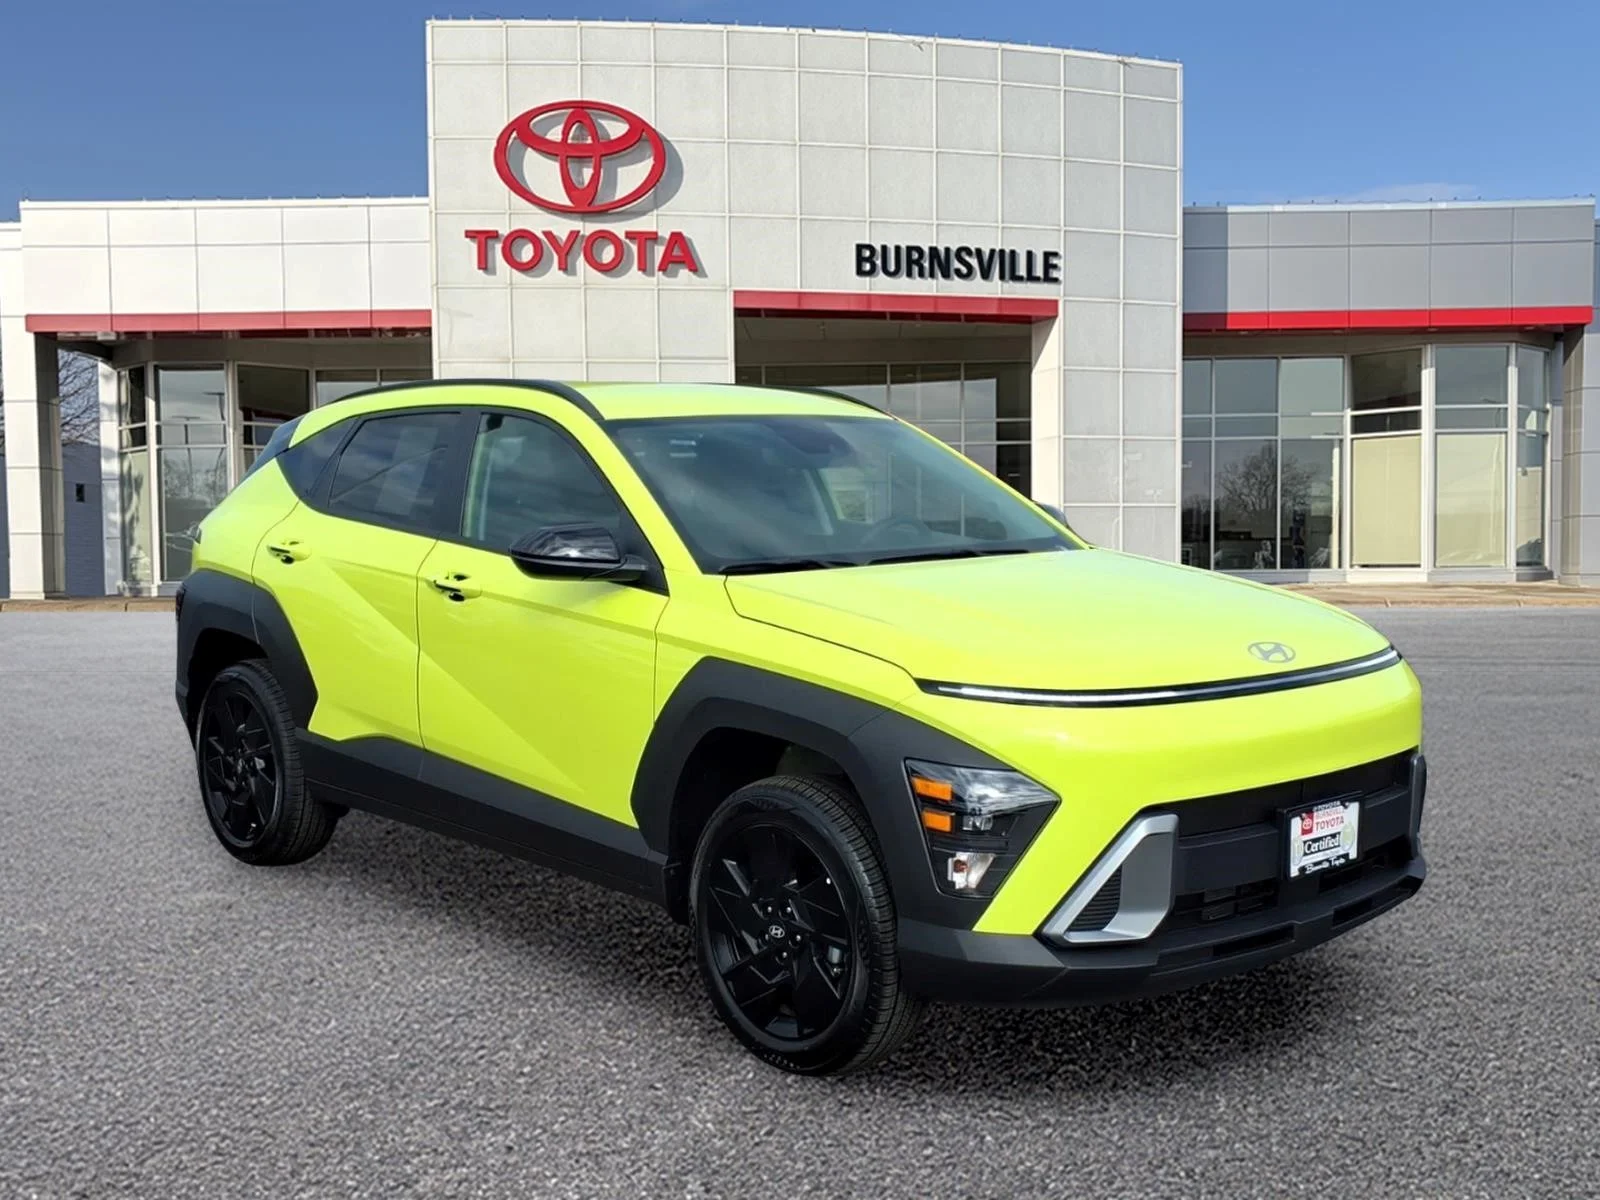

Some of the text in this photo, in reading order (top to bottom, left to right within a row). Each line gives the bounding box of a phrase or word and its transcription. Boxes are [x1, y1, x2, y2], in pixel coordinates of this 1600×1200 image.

[464, 229, 699, 272] TOYOTA
[855, 243, 1062, 284] BURNSVILLE
[1315, 816, 1345, 831] TOYOTA
[1304, 834, 1340, 854] Certified
